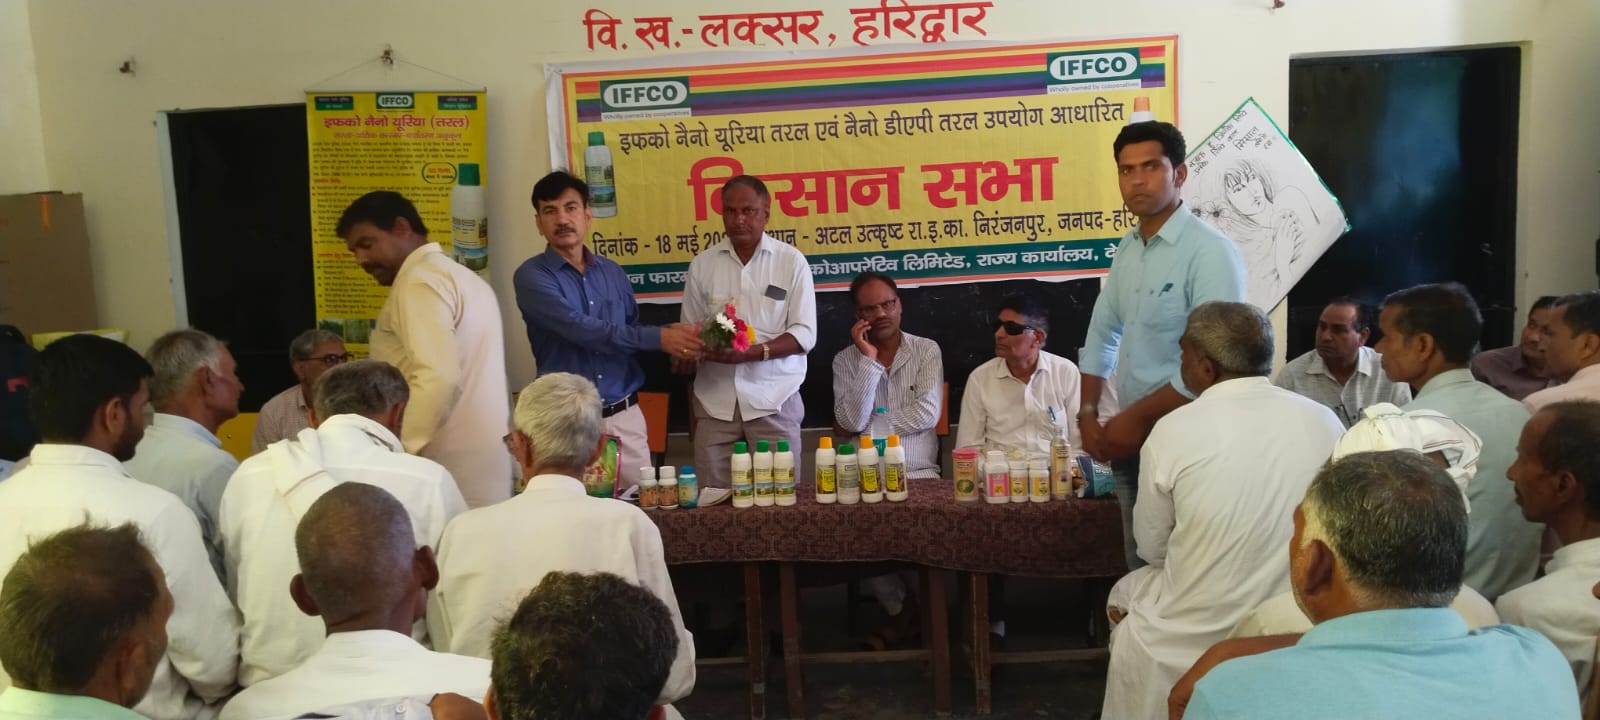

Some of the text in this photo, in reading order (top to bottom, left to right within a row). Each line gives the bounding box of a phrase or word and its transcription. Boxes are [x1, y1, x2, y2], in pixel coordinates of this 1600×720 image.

[850, 0, 994, 46] हरिद्वार
[1059, 56, 1127, 77] IFFCO
[382, 96, 409, 106] IFFCO
[612, 84, 678, 104] IFFCO
[323, 113, 470, 132] इफको नैनो यूरिया (तरल)
[619, 97, 1125, 154] इफको नैनो यूरिया तरल एवं नैनो डीएपी तरल उपयोग आधारित
[921, 156, 1059, 209] सभा
[592, 231, 639, 257] दिनांक
[656, 235, 671, 254] 18
[676, 225, 700, 257] मई
[815, 224, 853, 247] अटल
[859, 221, 903, 249] उत्कृष्ट
[973, 209, 1053, 241] निरंजनपुर,
[903, 252, 971, 272] लिमिटेड,
[977, 250, 1017, 267] राज्य
[1021, 245, 1099, 265] कार्यालय,
